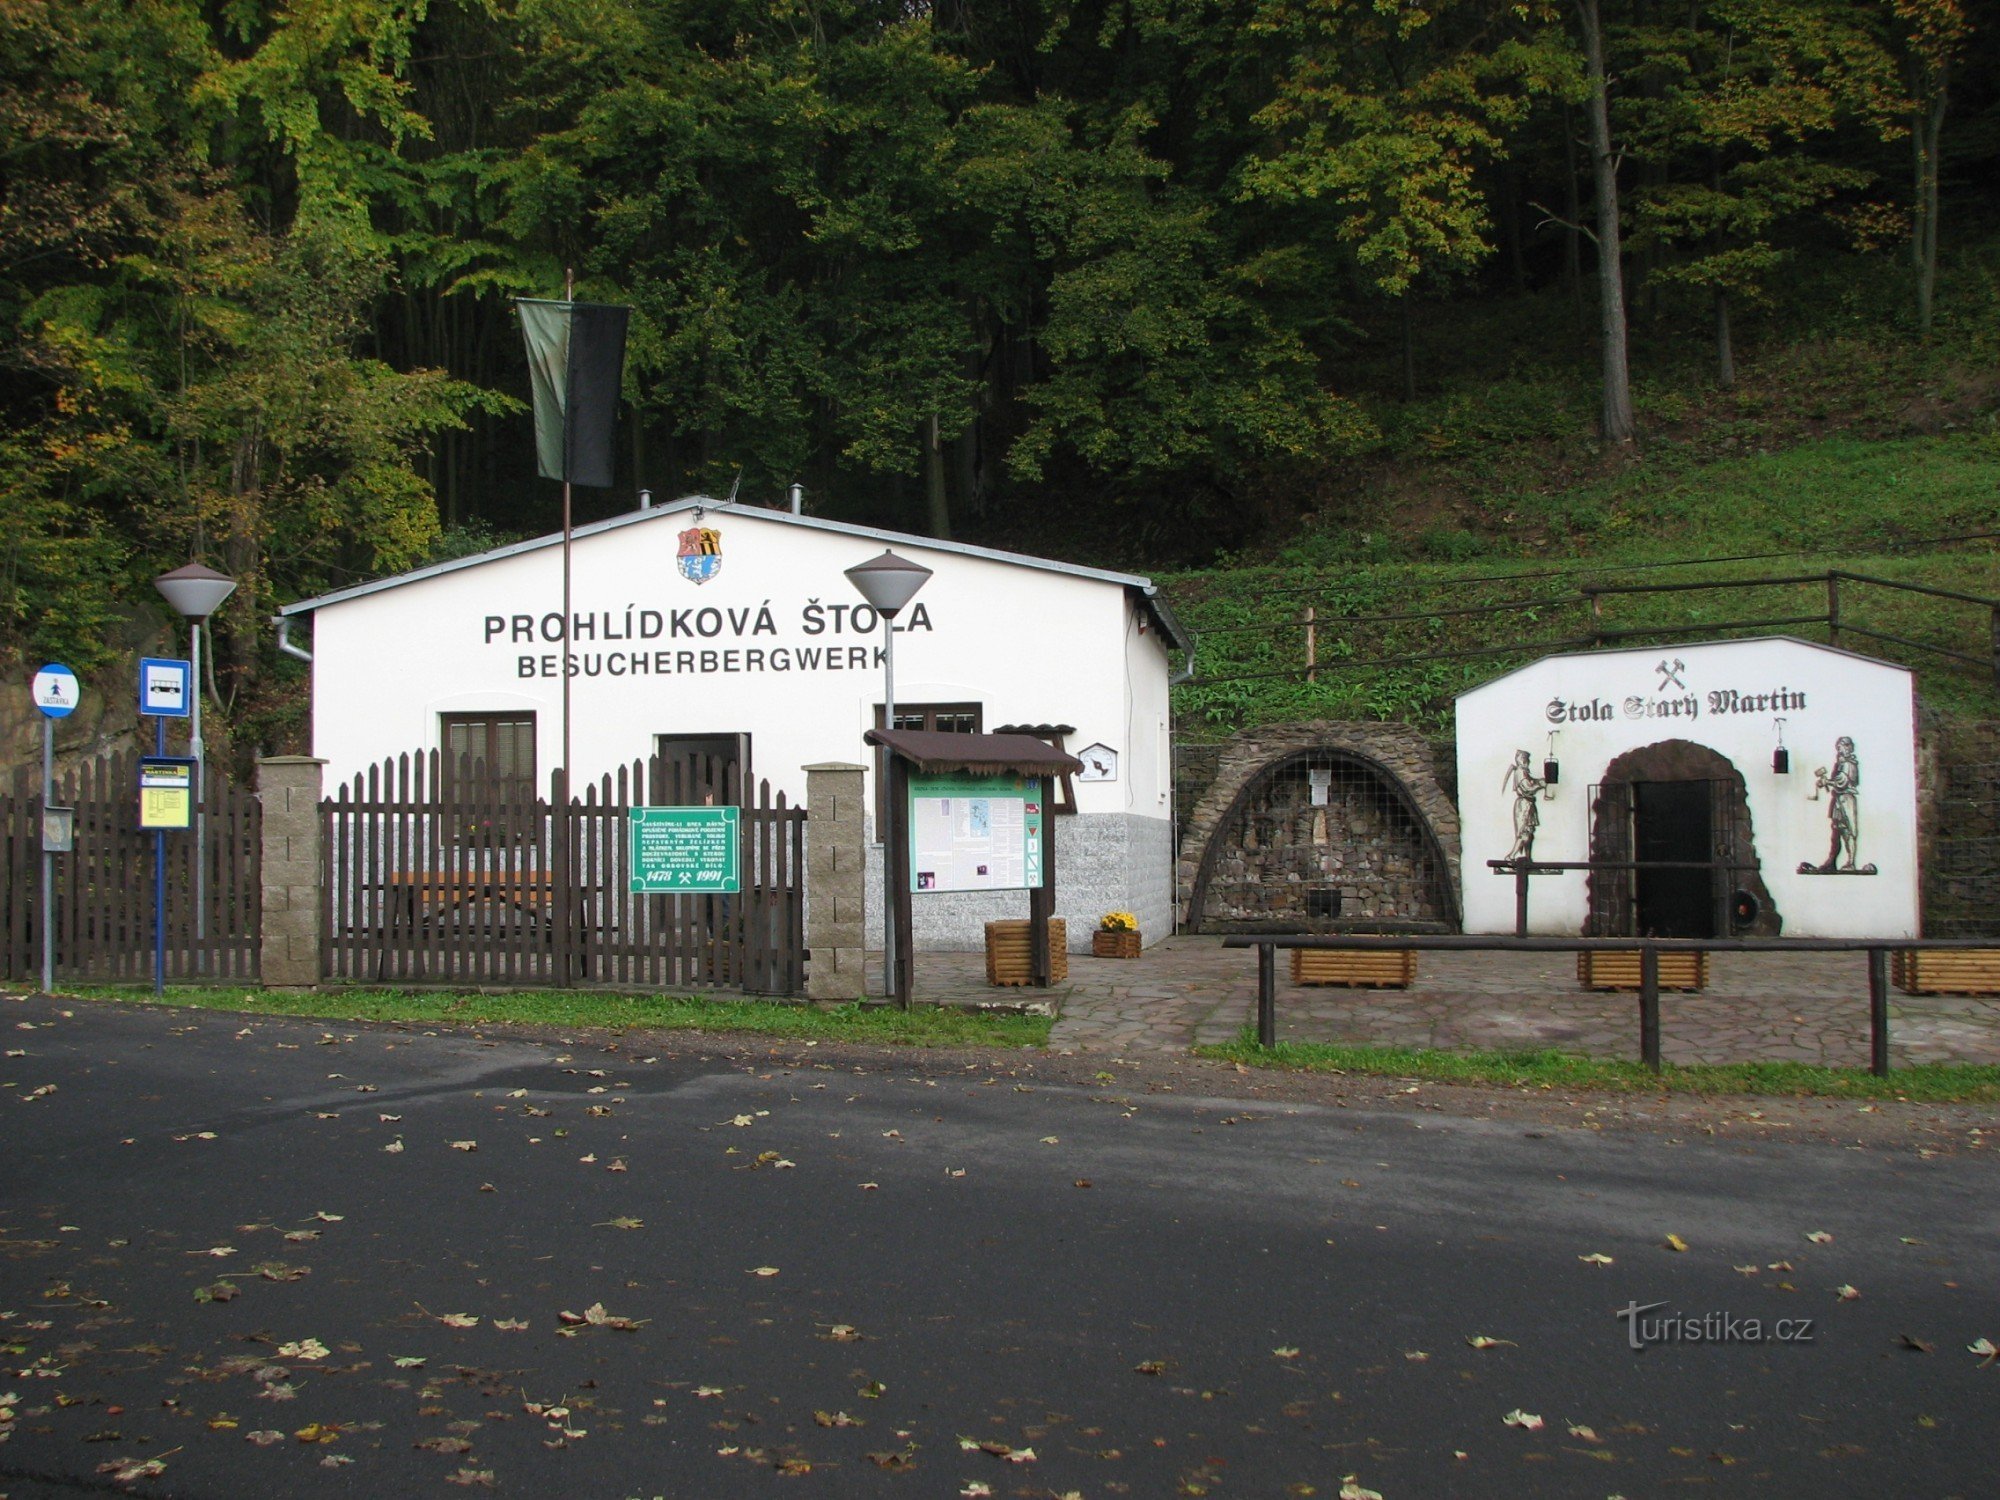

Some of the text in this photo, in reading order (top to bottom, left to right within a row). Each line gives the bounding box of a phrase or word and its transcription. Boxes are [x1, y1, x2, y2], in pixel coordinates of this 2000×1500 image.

[484, 598, 778, 643] PROHLÍDKOVÁ
[518, 646, 887, 678] BESUCHERBERGWERK
[1545, 685, 1808, 725] Štola Starý Martin
[646, 870, 722, 882] 1478 1991
